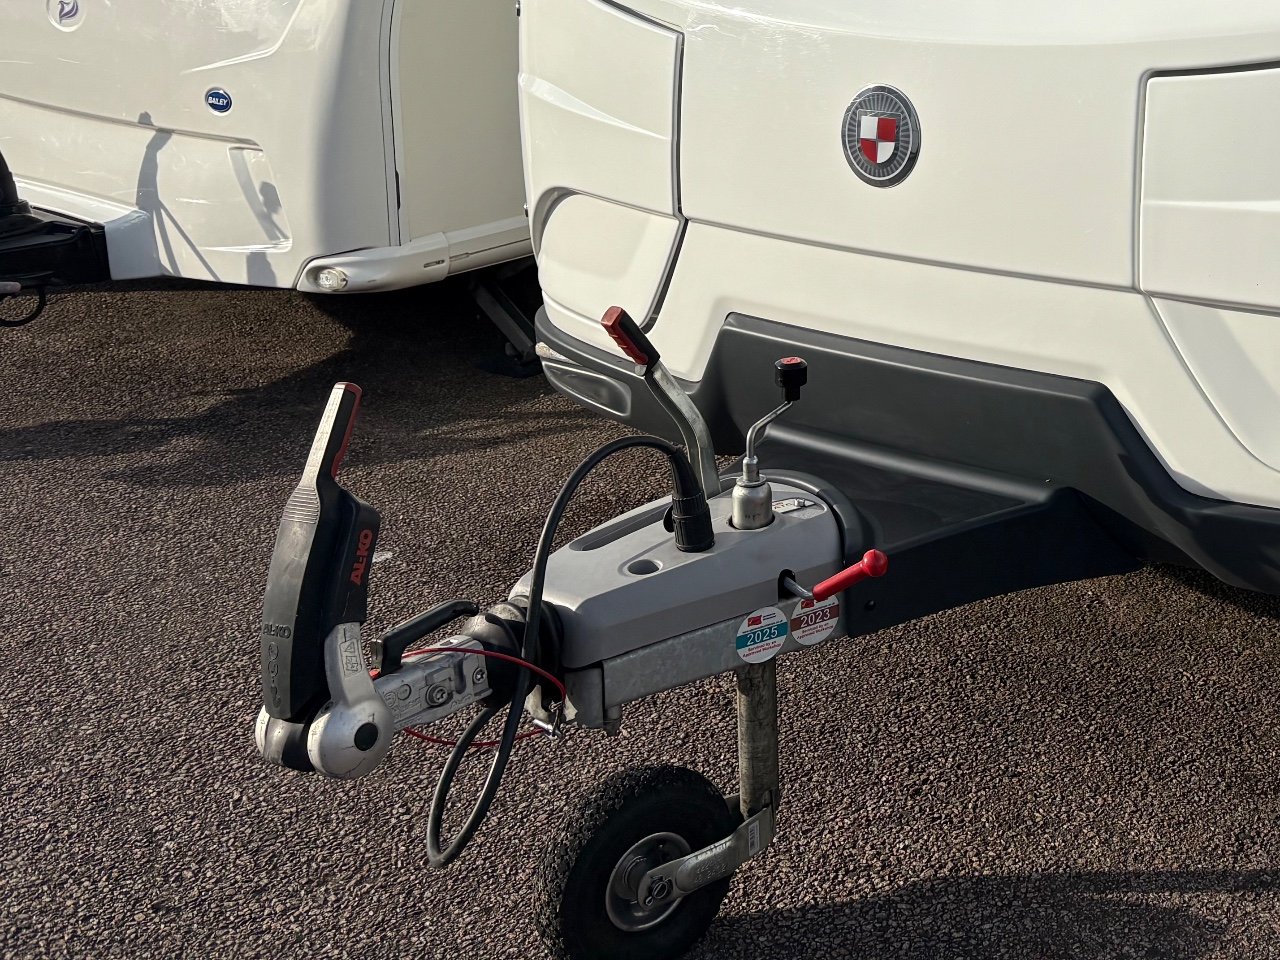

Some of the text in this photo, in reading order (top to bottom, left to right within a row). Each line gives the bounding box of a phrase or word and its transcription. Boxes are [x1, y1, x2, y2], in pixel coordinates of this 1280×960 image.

[208, 96, 228, 106] BAILEY
[350, 528, 374, 586] AL-KO
[800, 608, 831, 628] 2023
[263, 622, 292, 639] AL-KO
[746, 625, 779, 646] 2025
